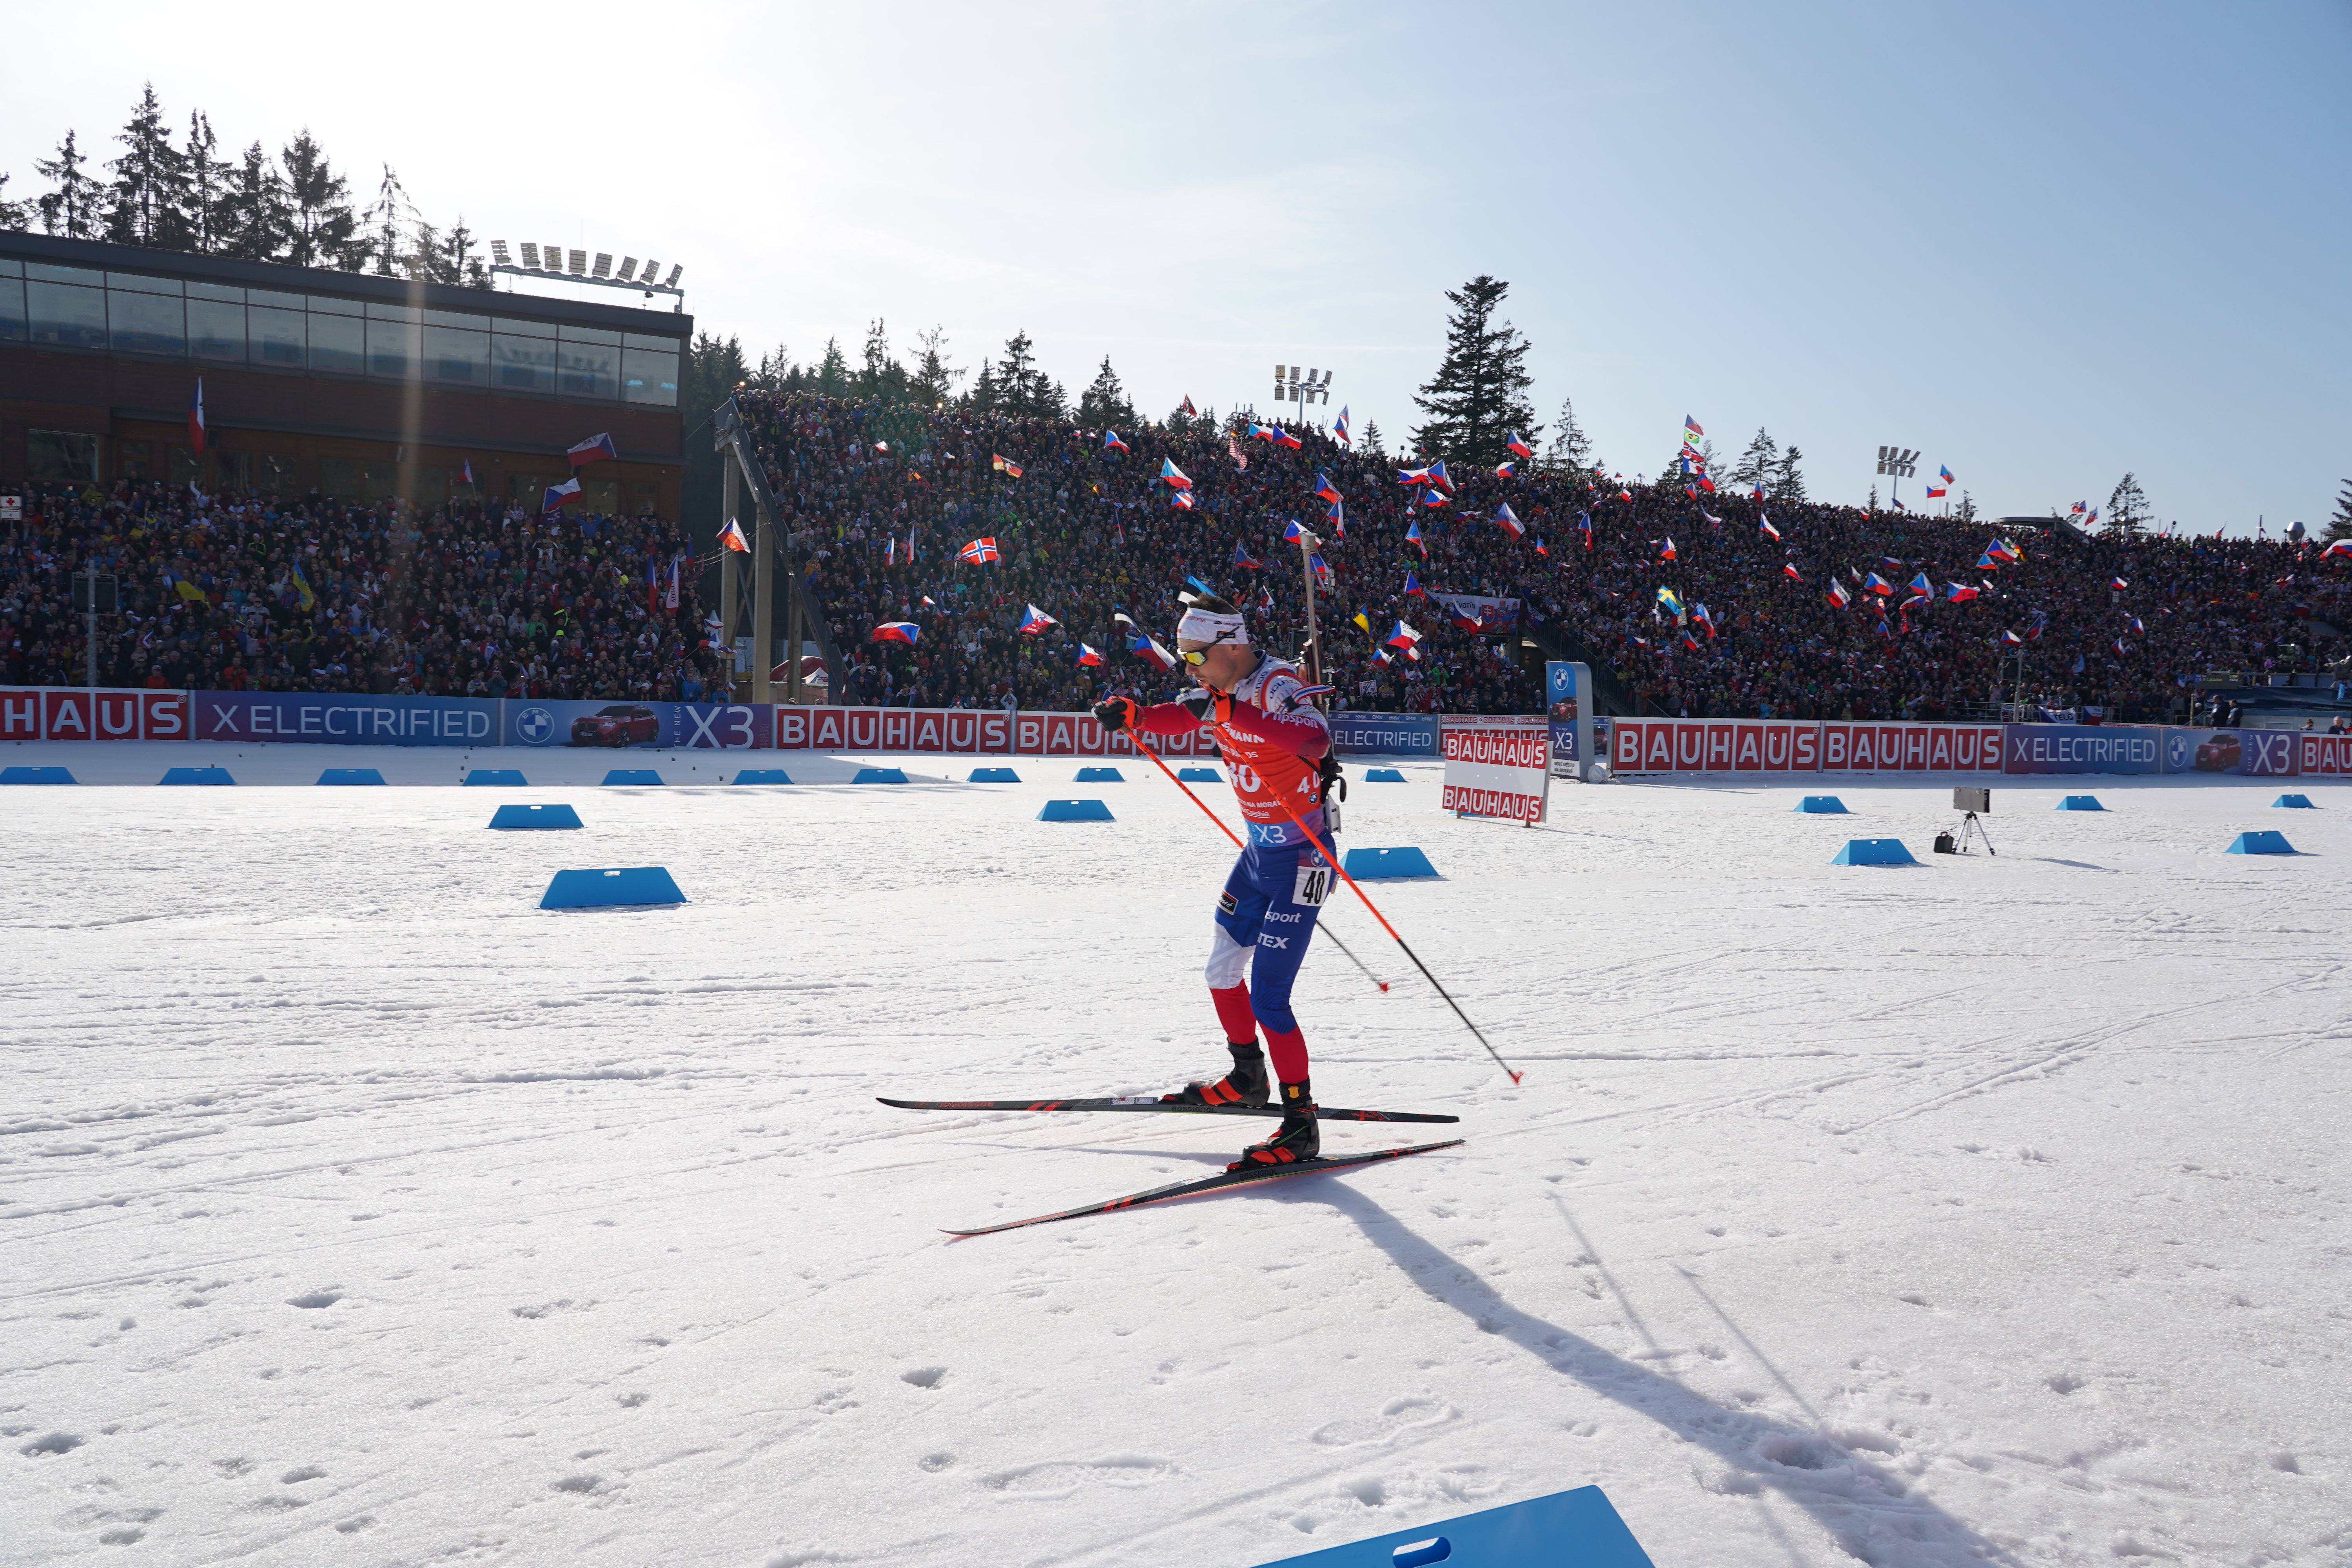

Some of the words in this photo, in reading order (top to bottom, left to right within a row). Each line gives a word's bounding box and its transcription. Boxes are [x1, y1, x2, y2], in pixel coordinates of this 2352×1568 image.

[5, 699, 181, 733] HAUS
[213, 705, 239, 733] X
[251, 706, 490, 737] ELECTRIFIED
[685, 706, 754, 748] X3
[2054, 711, 2074, 721] TELČ
[784, 715, 1006, 747] BAUHAUS
[1335, 730, 1431, 747] ELECTRIFIED
[1555, 732, 1573, 750] X3
[1447, 739, 1545, 764] BAUHAUS
[1619, 730, 1815, 764] BAUHAUS
[1828, 733, 2000, 763] BAUHAUS
[2014, 738, 2028, 762] X
[2033, 738, 2155, 762] ELECTRIFIED
[2252, 735, 2290, 773] X3
[2304, 742, 2352, 768] BAU
[1227, 761, 1261, 793] 40
[1257, 798, 1285, 808] MORAV
[1443, 789, 1539, 819] BAUHAUS
[1254, 825, 1287, 843] X3
[1302, 870, 1325, 904] 40
[1265, 911, 1301, 923] sport
[1257, 932, 1290, 949] TEX
[1239, 1167, 1278, 1180] ROSSIGNOL
